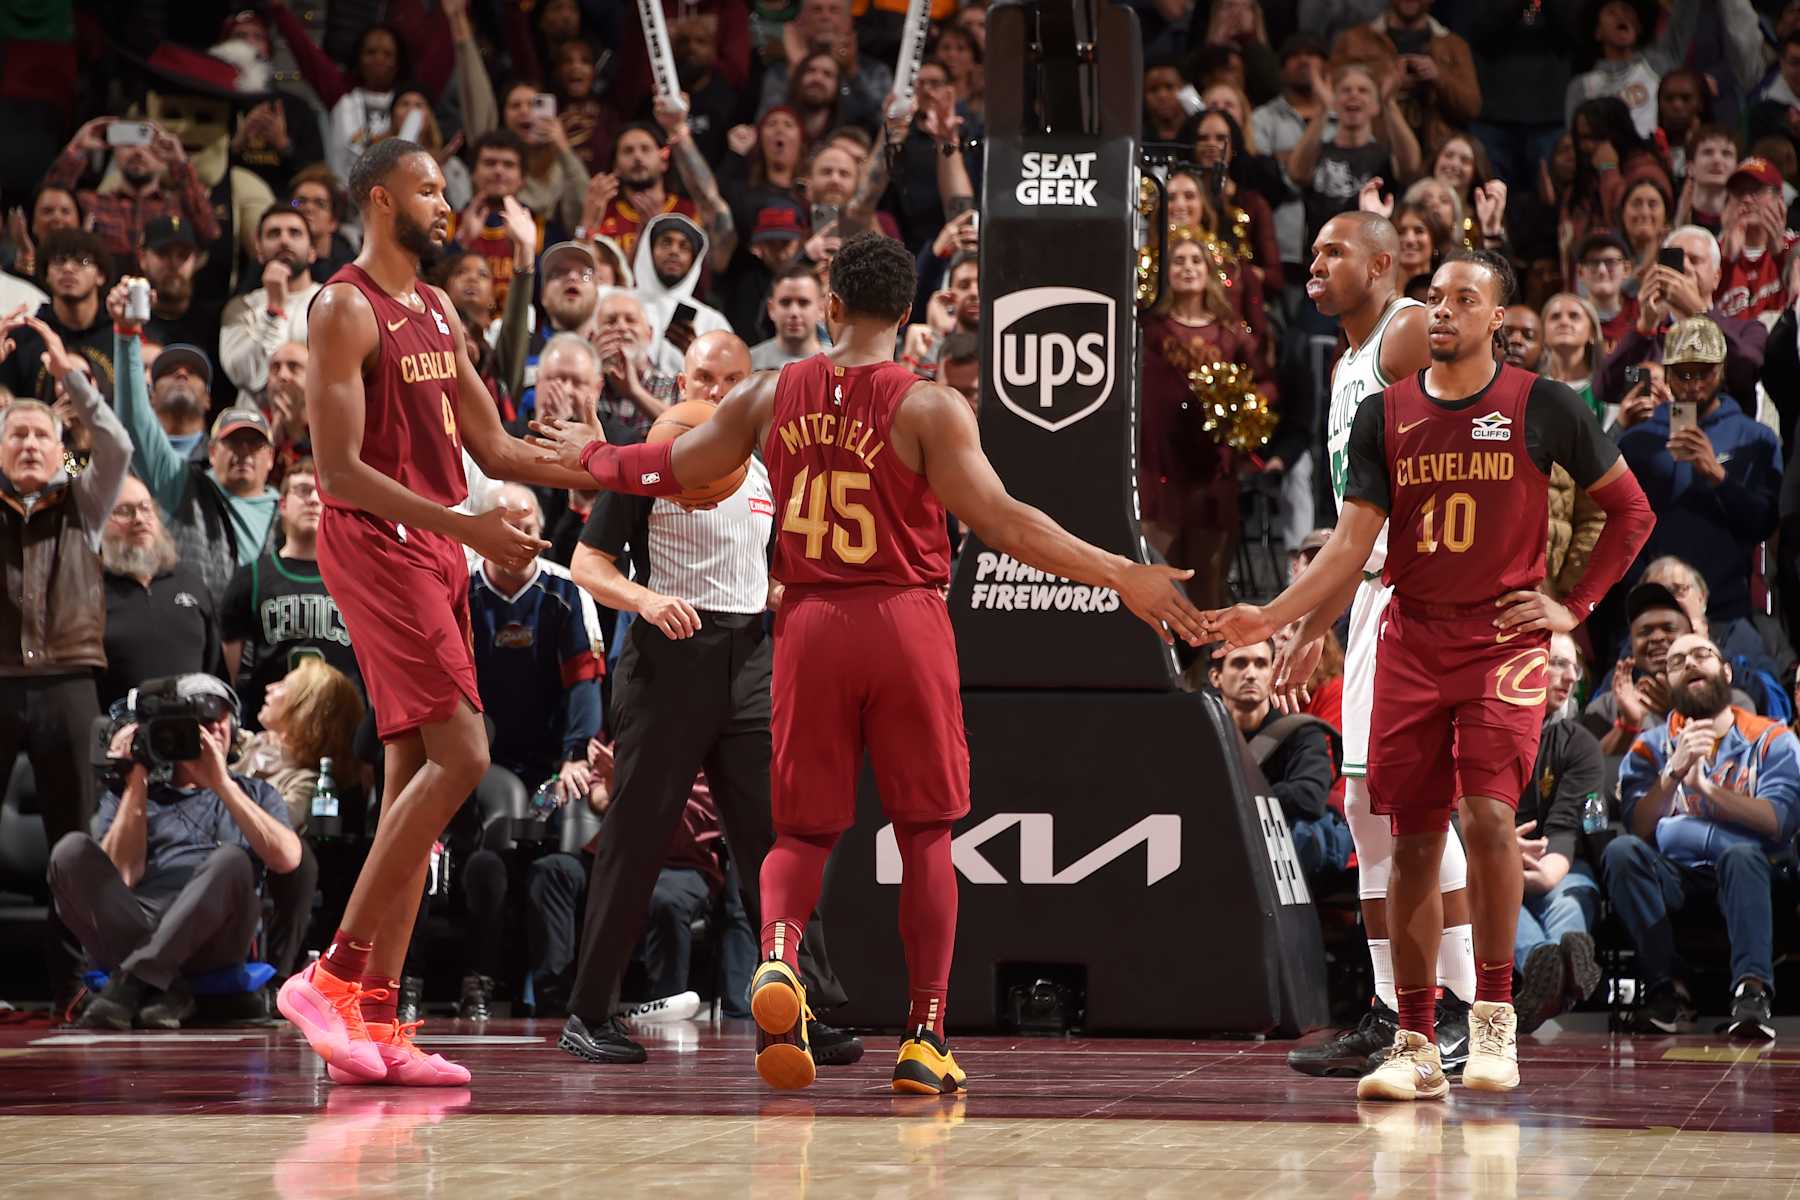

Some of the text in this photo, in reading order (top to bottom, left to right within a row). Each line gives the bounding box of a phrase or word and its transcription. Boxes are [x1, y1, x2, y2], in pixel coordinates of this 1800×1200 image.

[1022, 152, 1097, 179] SEAT
[1016, 179, 1098, 206] GEEK
[441, 391, 457, 448] 4
[1473, 430, 1509, 438] CLIFFS
[778, 412, 885, 470] MITCHELL
[1396, 452, 1514, 487] CLEVELAND
[782, 464, 877, 564] 45
[1416, 492, 1477, 552] 10
[971, 584, 1121, 614] FIREWORKS
